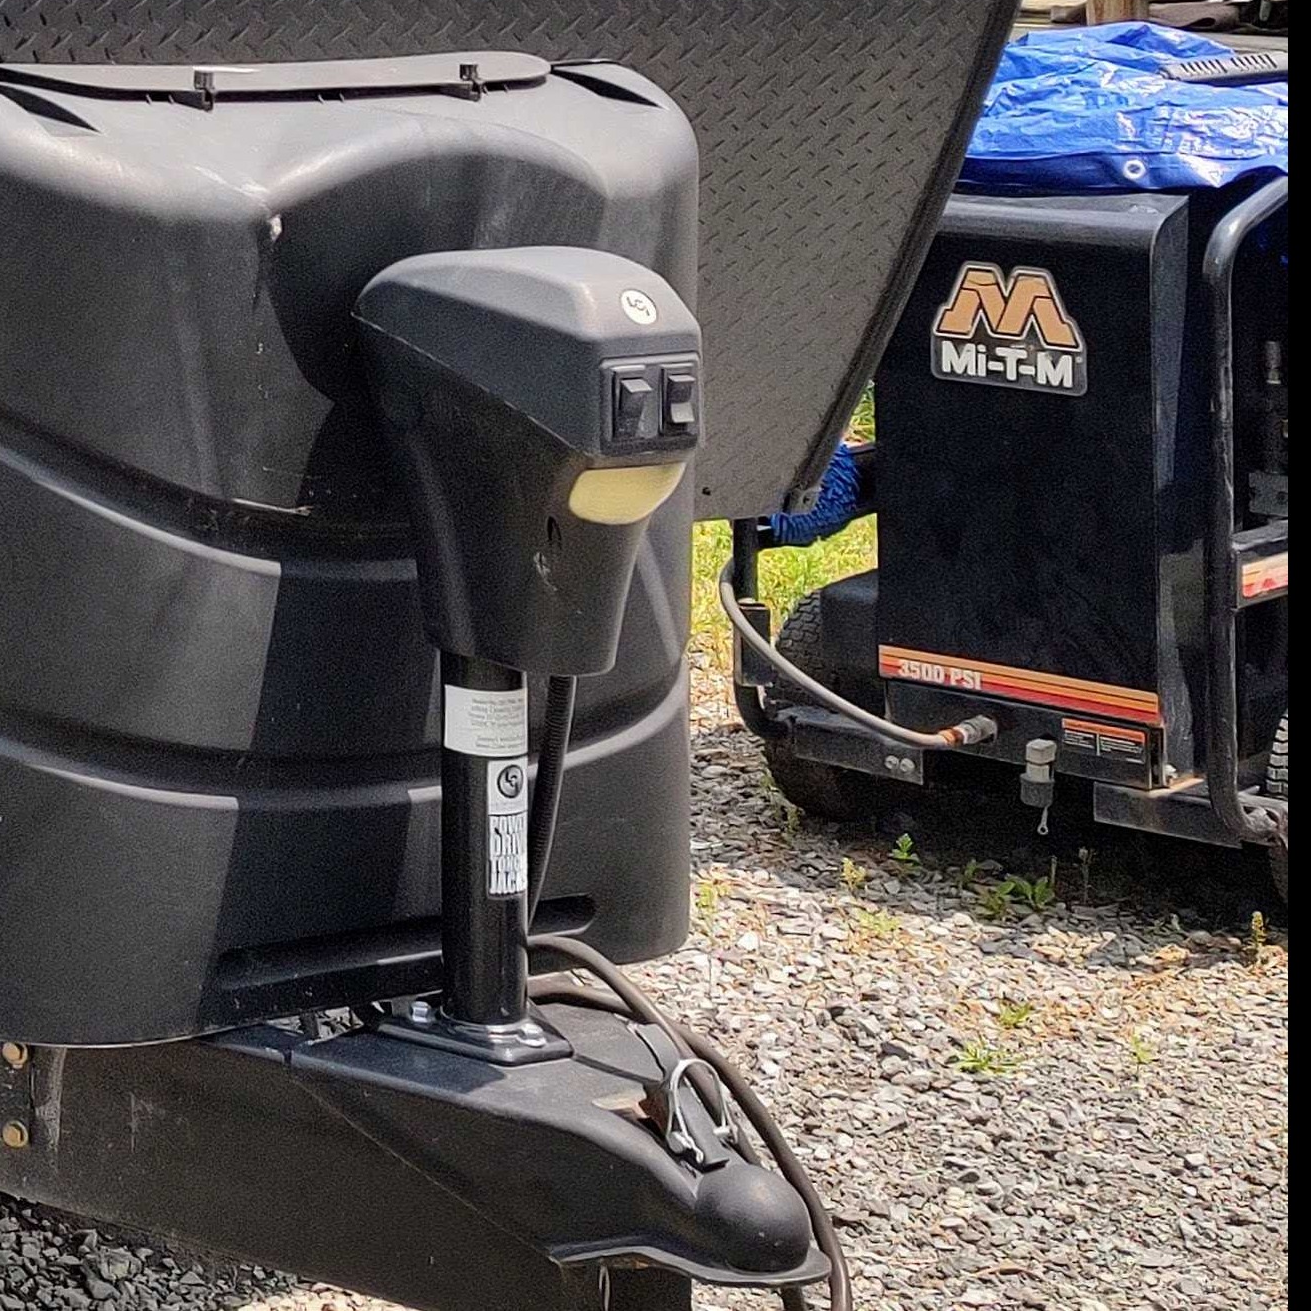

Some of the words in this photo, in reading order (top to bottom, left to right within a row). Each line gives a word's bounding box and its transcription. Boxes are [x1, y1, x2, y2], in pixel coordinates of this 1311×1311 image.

[941, 340, 1074, 389] Mi-T-M
[898, 658, 945, 684] 3500
[951, 667, 983, 691] PSI
